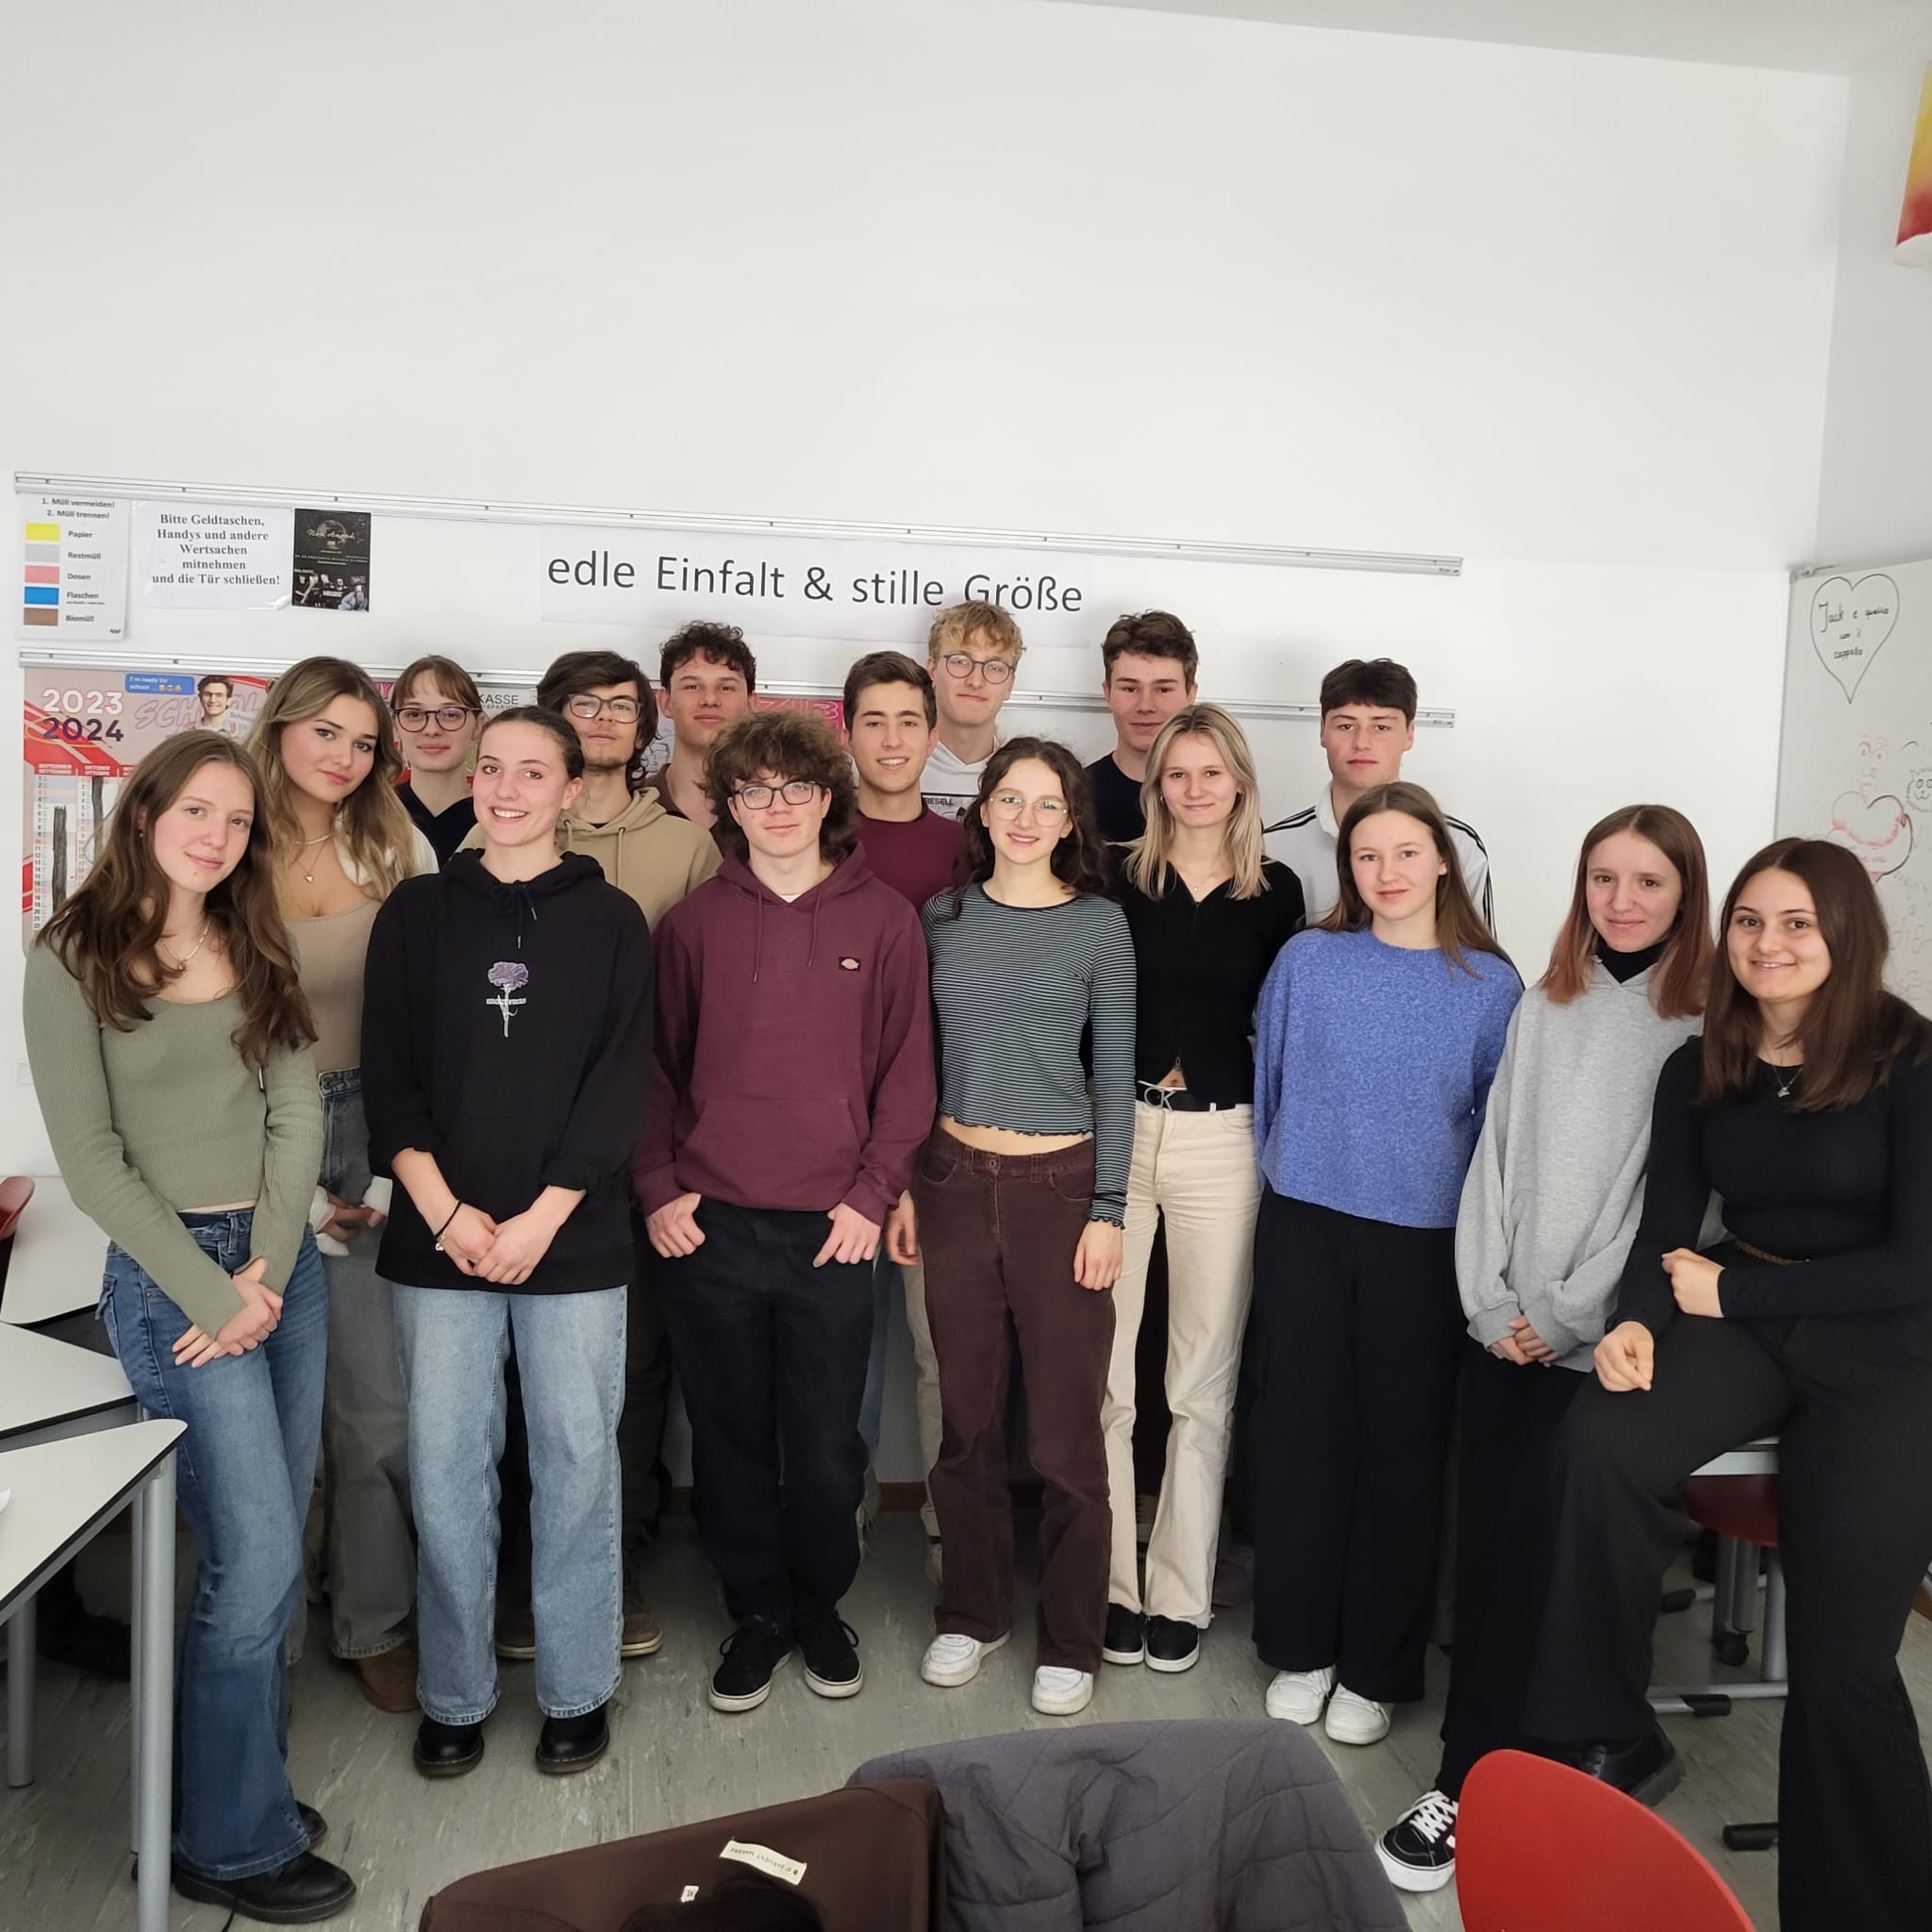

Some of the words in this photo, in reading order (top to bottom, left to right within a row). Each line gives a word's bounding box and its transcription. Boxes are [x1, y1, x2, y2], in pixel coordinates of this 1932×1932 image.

[71, 500, 115, 508] vermeiden!
[76, 511, 110, 520] trennen!
[160, 514, 188, 525] Bitte
[191, 514, 265, 526] Geldtaschen,
[68, 530, 92, 539] Papier
[158, 529, 201, 541] Handys
[205, 530, 226, 541] und
[230, 531, 269, 541] andere
[180, 544, 247, 555] Wertsachen
[182, 559, 246, 570] mitnehmen
[152, 574, 175, 584] und
[177, 574, 195, 584] die
[197, 574, 220, 584] Tür
[224, 575, 280, 585] schließen!
[548, 550, 635, 588] edle
[657, 556, 785, 598] Einfalt
[804, 566, 833, 601] &
[852, 570, 943, 606] stille
[964, 575, 1082, 611] Größe
[42, 689, 123, 715] 2023
[42, 717, 125, 741] 2024
